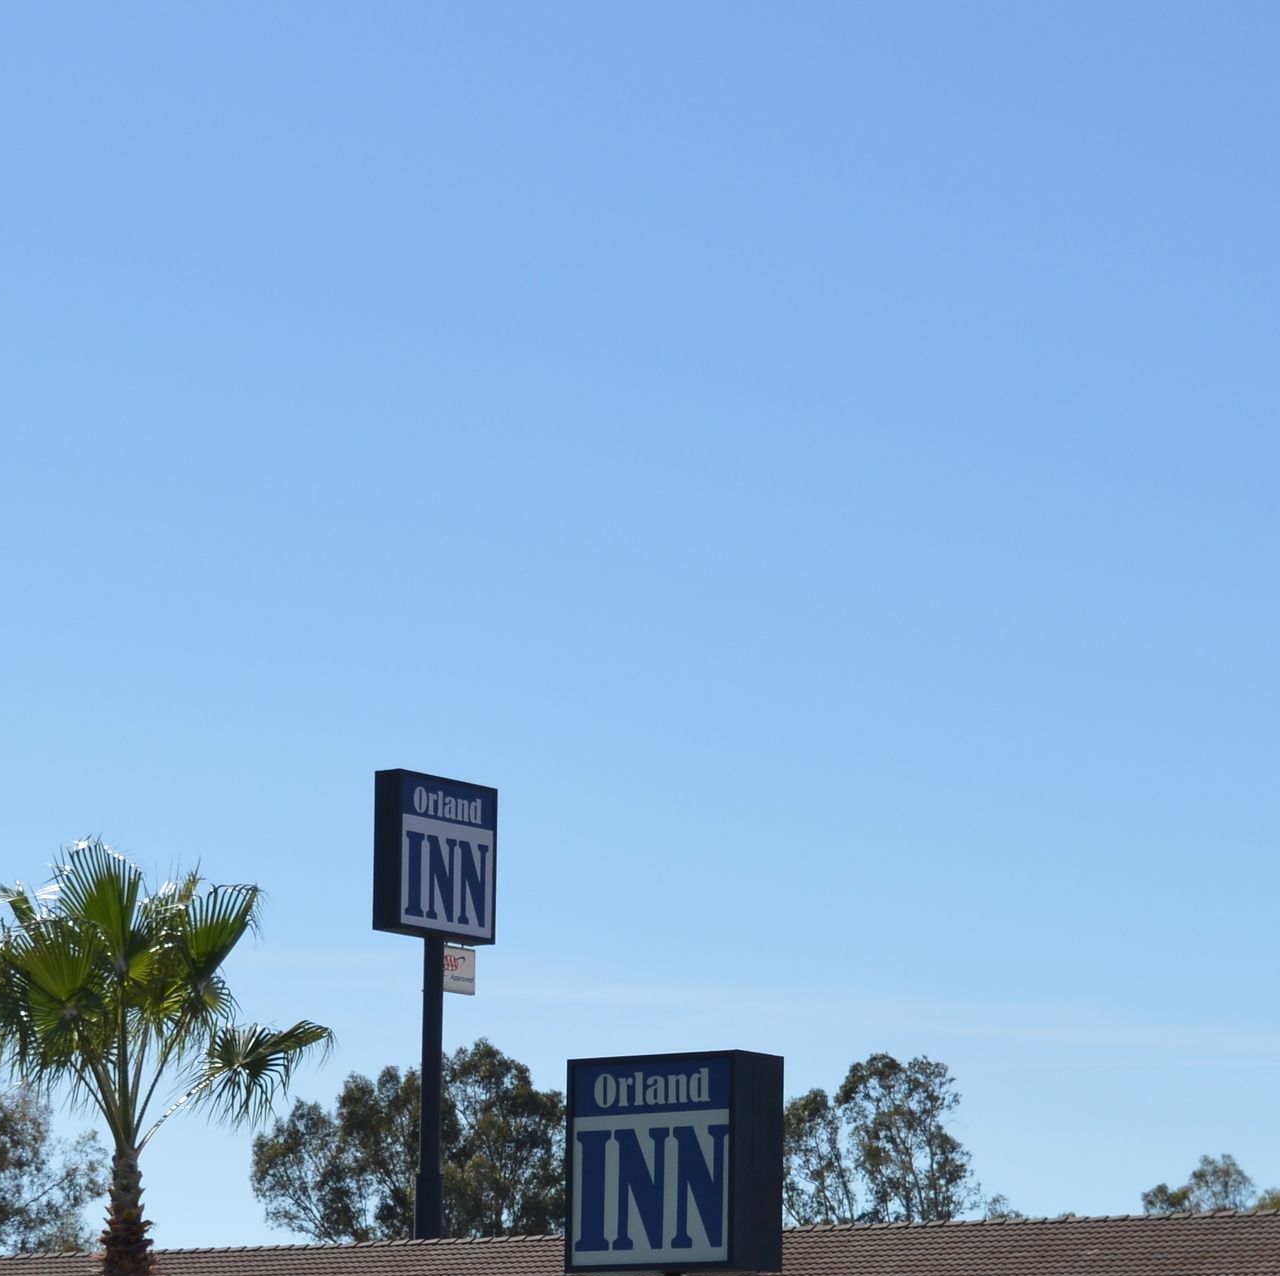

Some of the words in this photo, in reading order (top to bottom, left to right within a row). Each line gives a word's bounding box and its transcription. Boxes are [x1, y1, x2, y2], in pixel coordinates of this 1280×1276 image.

[413, 786, 482, 825] Orland
[404, 830, 489, 928] INN
[594, 1067, 710, 1108] Orland
[574, 1124, 729, 1252] INN
